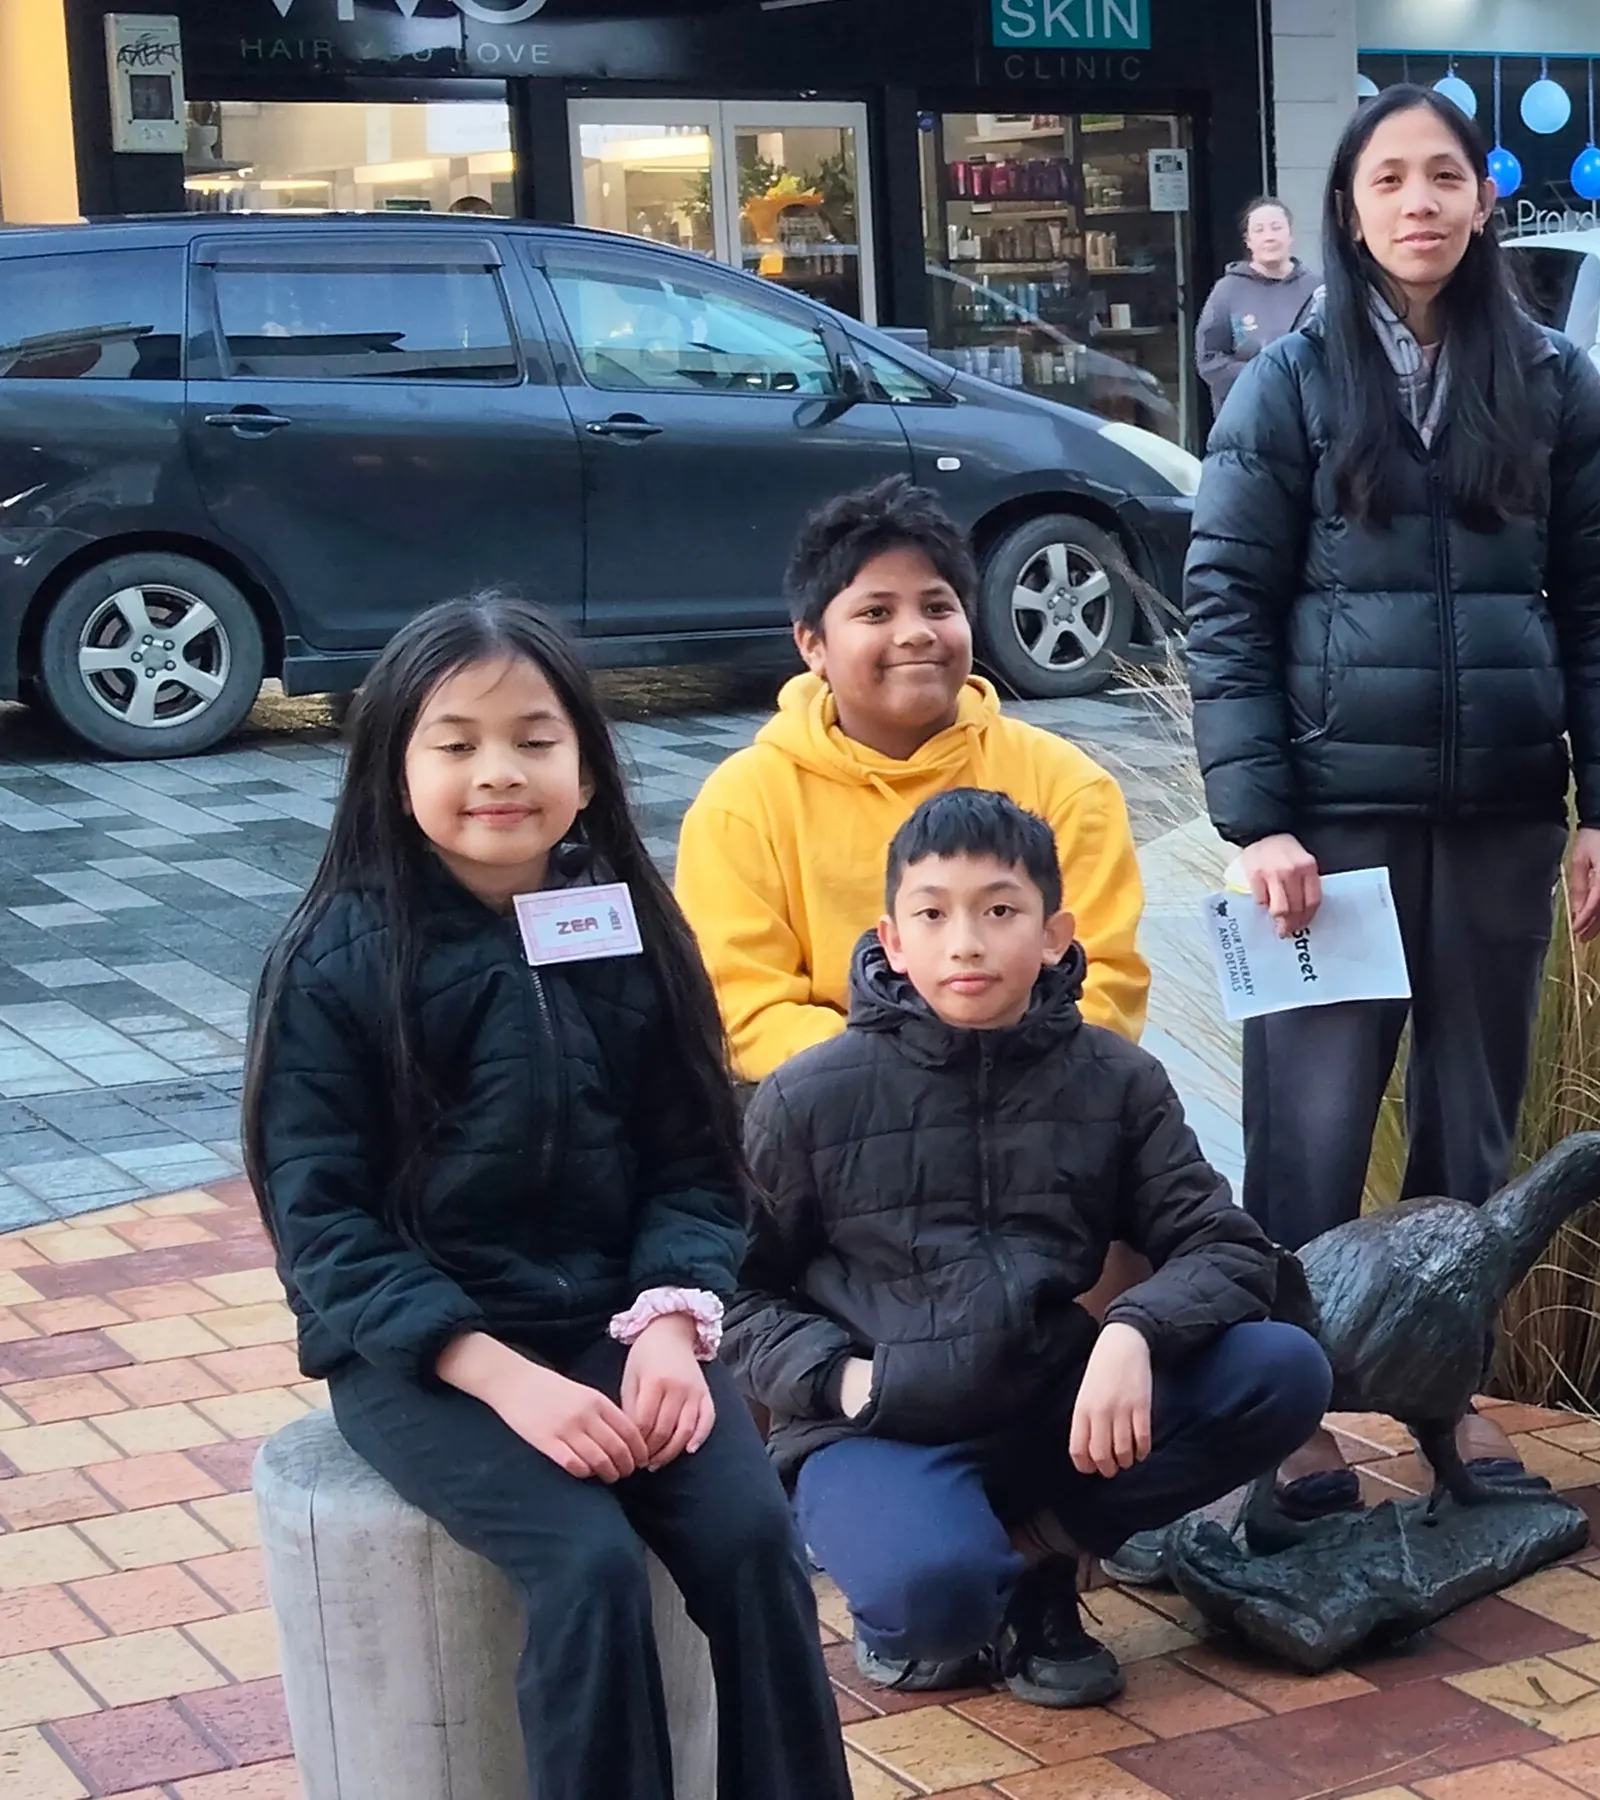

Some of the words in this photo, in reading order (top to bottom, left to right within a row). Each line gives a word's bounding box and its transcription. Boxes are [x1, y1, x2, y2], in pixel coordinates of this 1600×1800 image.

[1001, 0, 1139, 39] SKIN
[240, 38, 334, 60] HAIR
[1004, 54, 1142, 81] CLINIC
[1517, 199, 1597, 236] Proud
[1228, 917, 1243, 944] TOUR
[1218, 926, 1232, 950] AND
[1225, 952, 1243, 993] DETAILS
[1235, 946, 1256, 997] ITINERARY
[1291, 926, 1319, 983] Street
